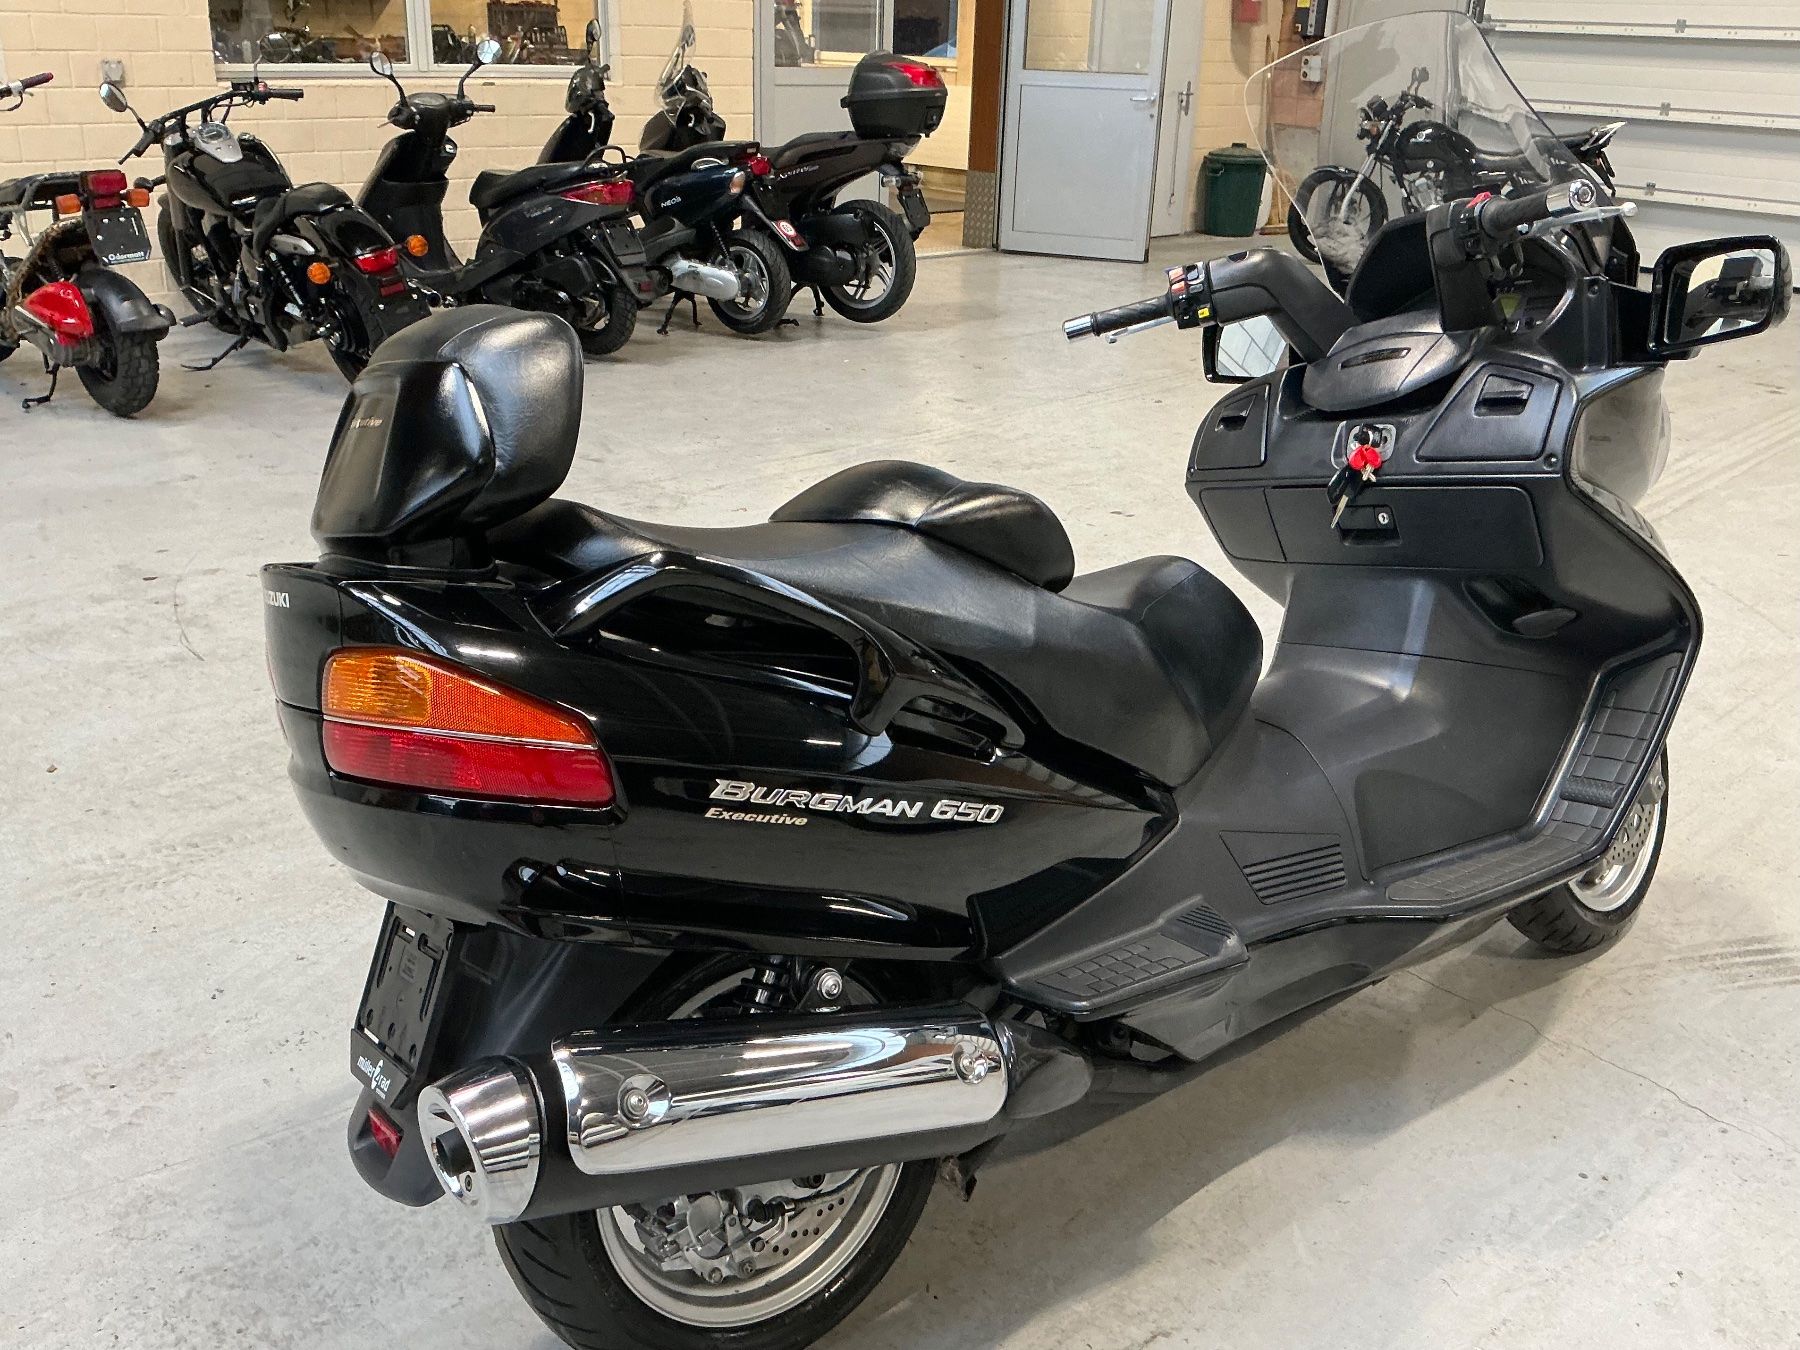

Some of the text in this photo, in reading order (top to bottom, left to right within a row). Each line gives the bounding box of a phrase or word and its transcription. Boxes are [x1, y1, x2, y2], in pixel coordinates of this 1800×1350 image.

[704, 807, 808, 826] Executive
[709, 778, 1005, 824] BURGMAN 650
